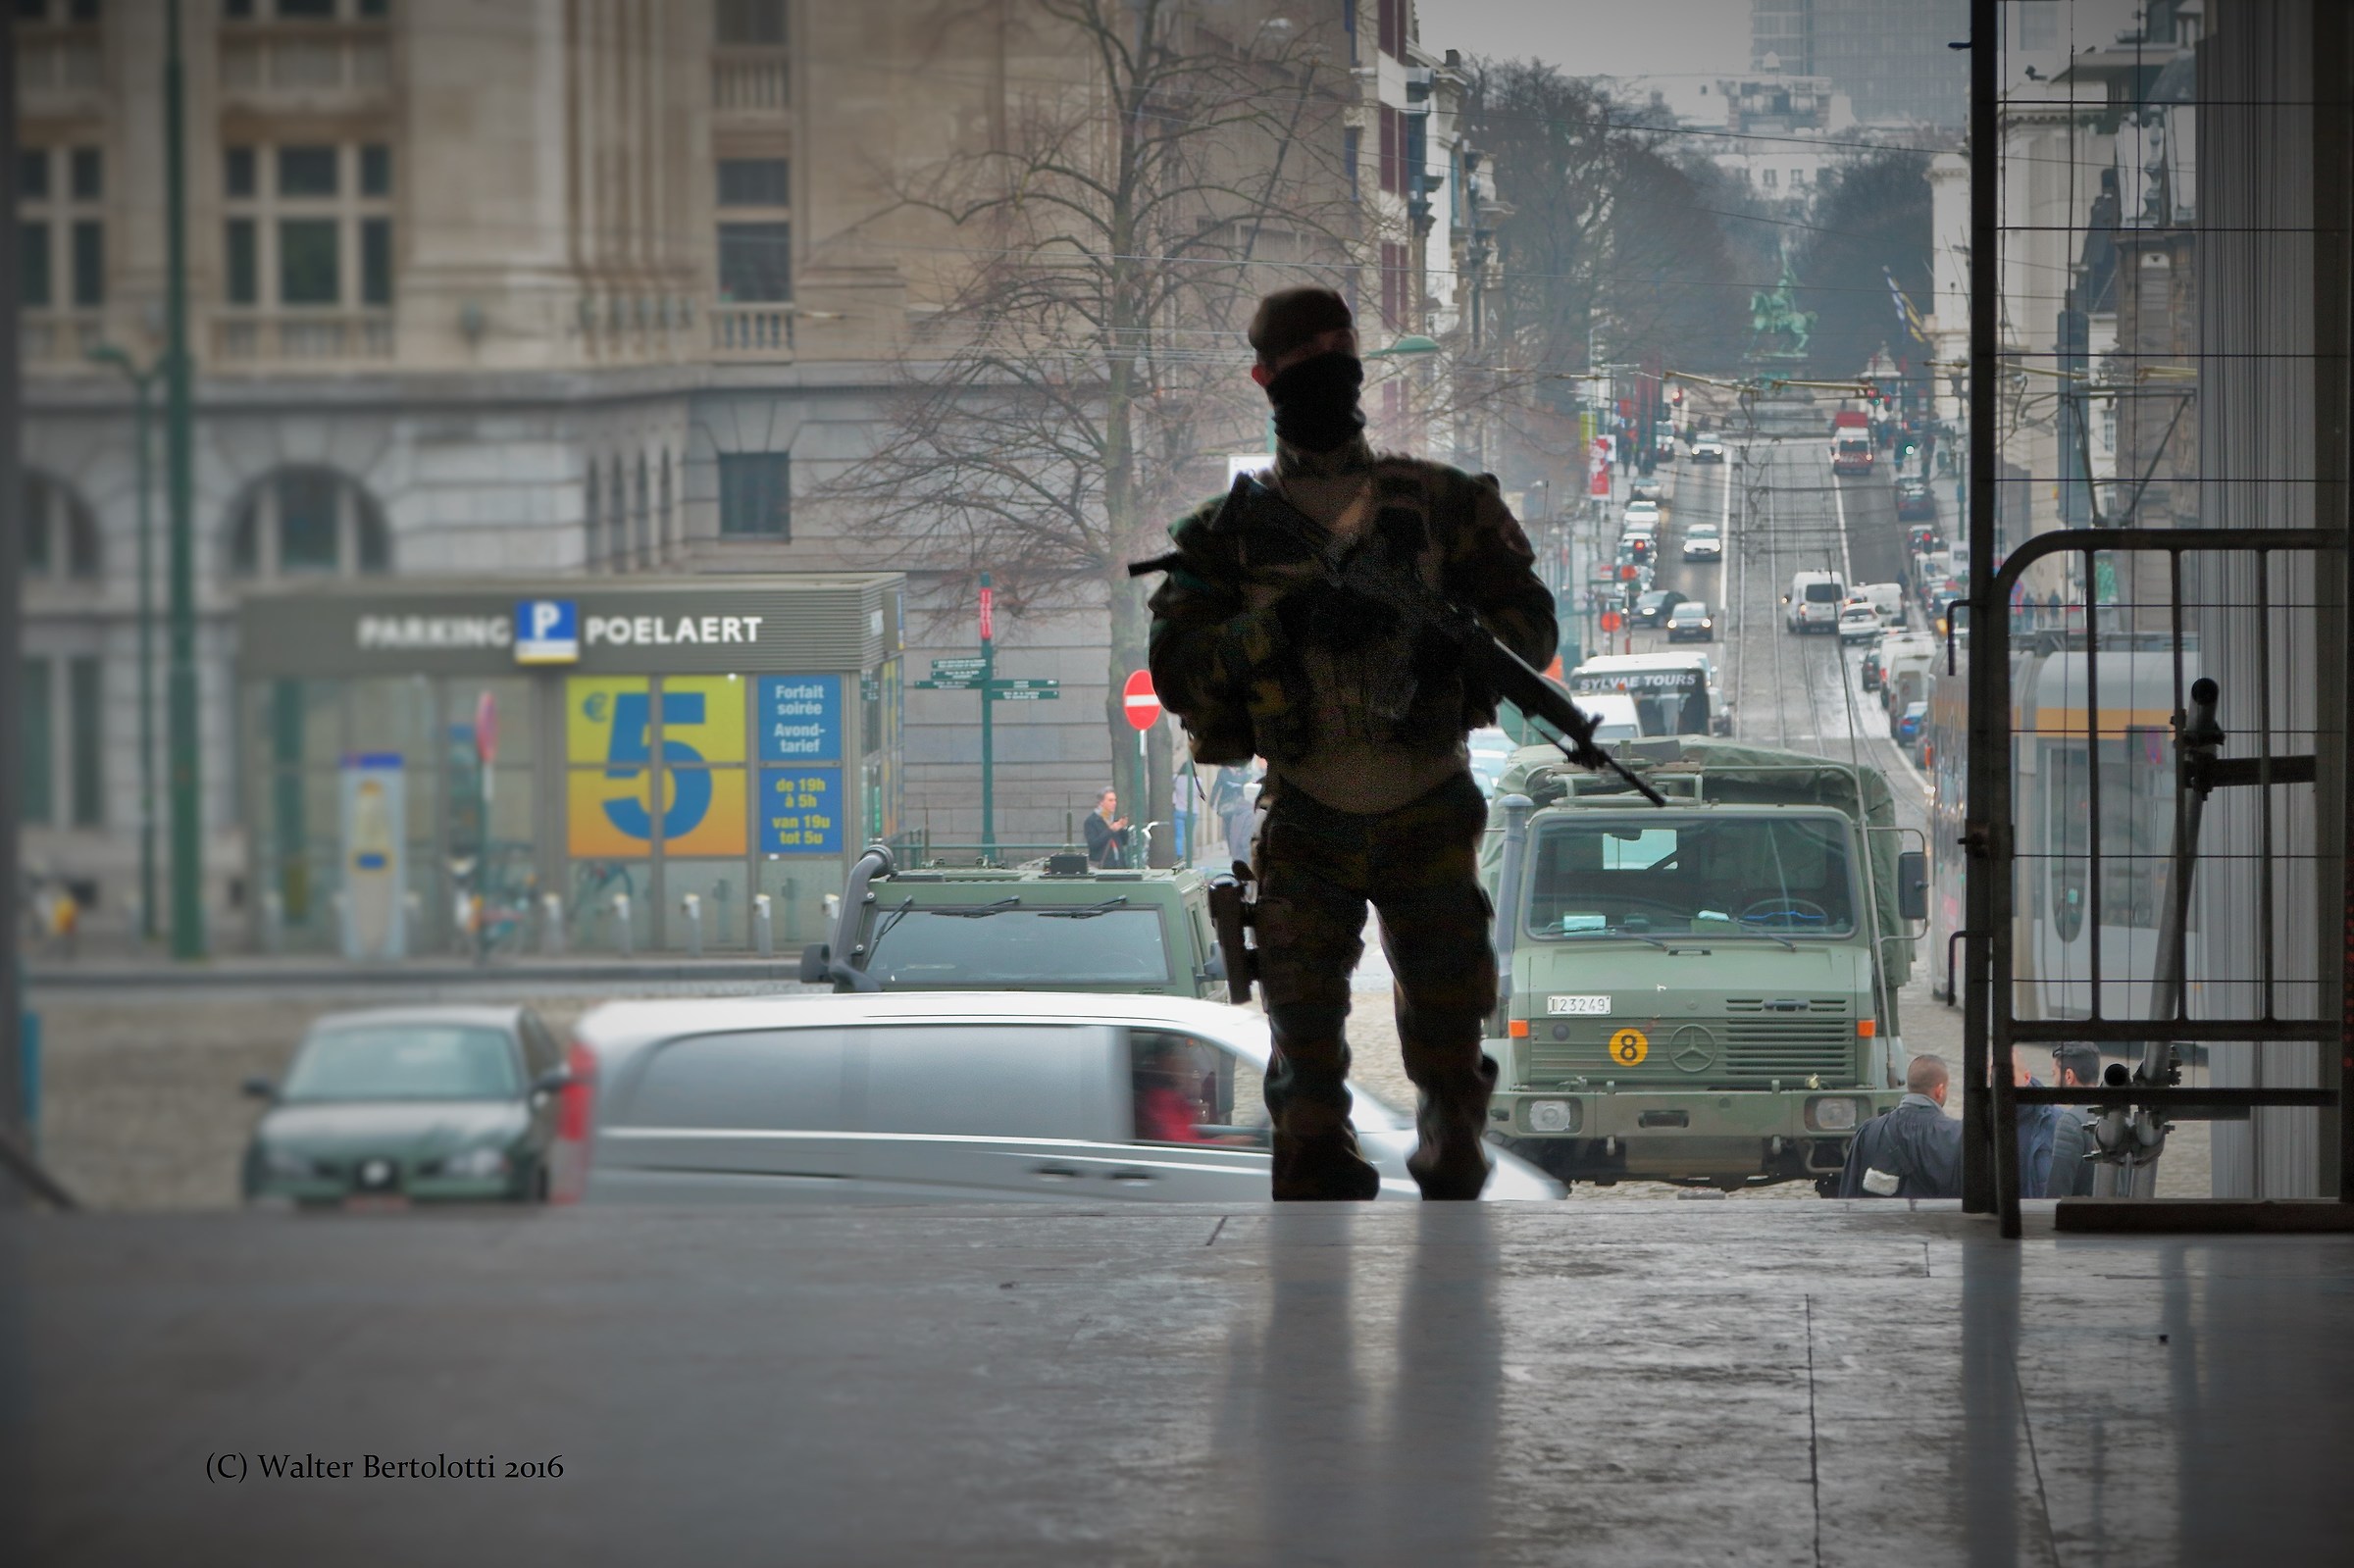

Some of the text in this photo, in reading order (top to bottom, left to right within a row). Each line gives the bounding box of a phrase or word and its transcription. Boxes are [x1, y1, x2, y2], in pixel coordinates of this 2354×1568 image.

[533, 601, 561, 641] P
[357, 615, 512, 648] PARKING
[586, 616, 763, 645] POELAERT
[1580, 674, 1696, 690] SYLVAE TOURS
[775, 684, 824, 699] Forfait
[777, 700, 823, 715] soirée
[774, 723, 826, 736] Avond-
[780, 738, 821, 753] tarief
[776, 779, 826, 792] de 19h
[798, 794, 817, 808] 5h
[772, 815, 831, 829] van 19u
[780, 832, 823, 845] tot 5u
[1620, 1035, 1638, 1060] 8
